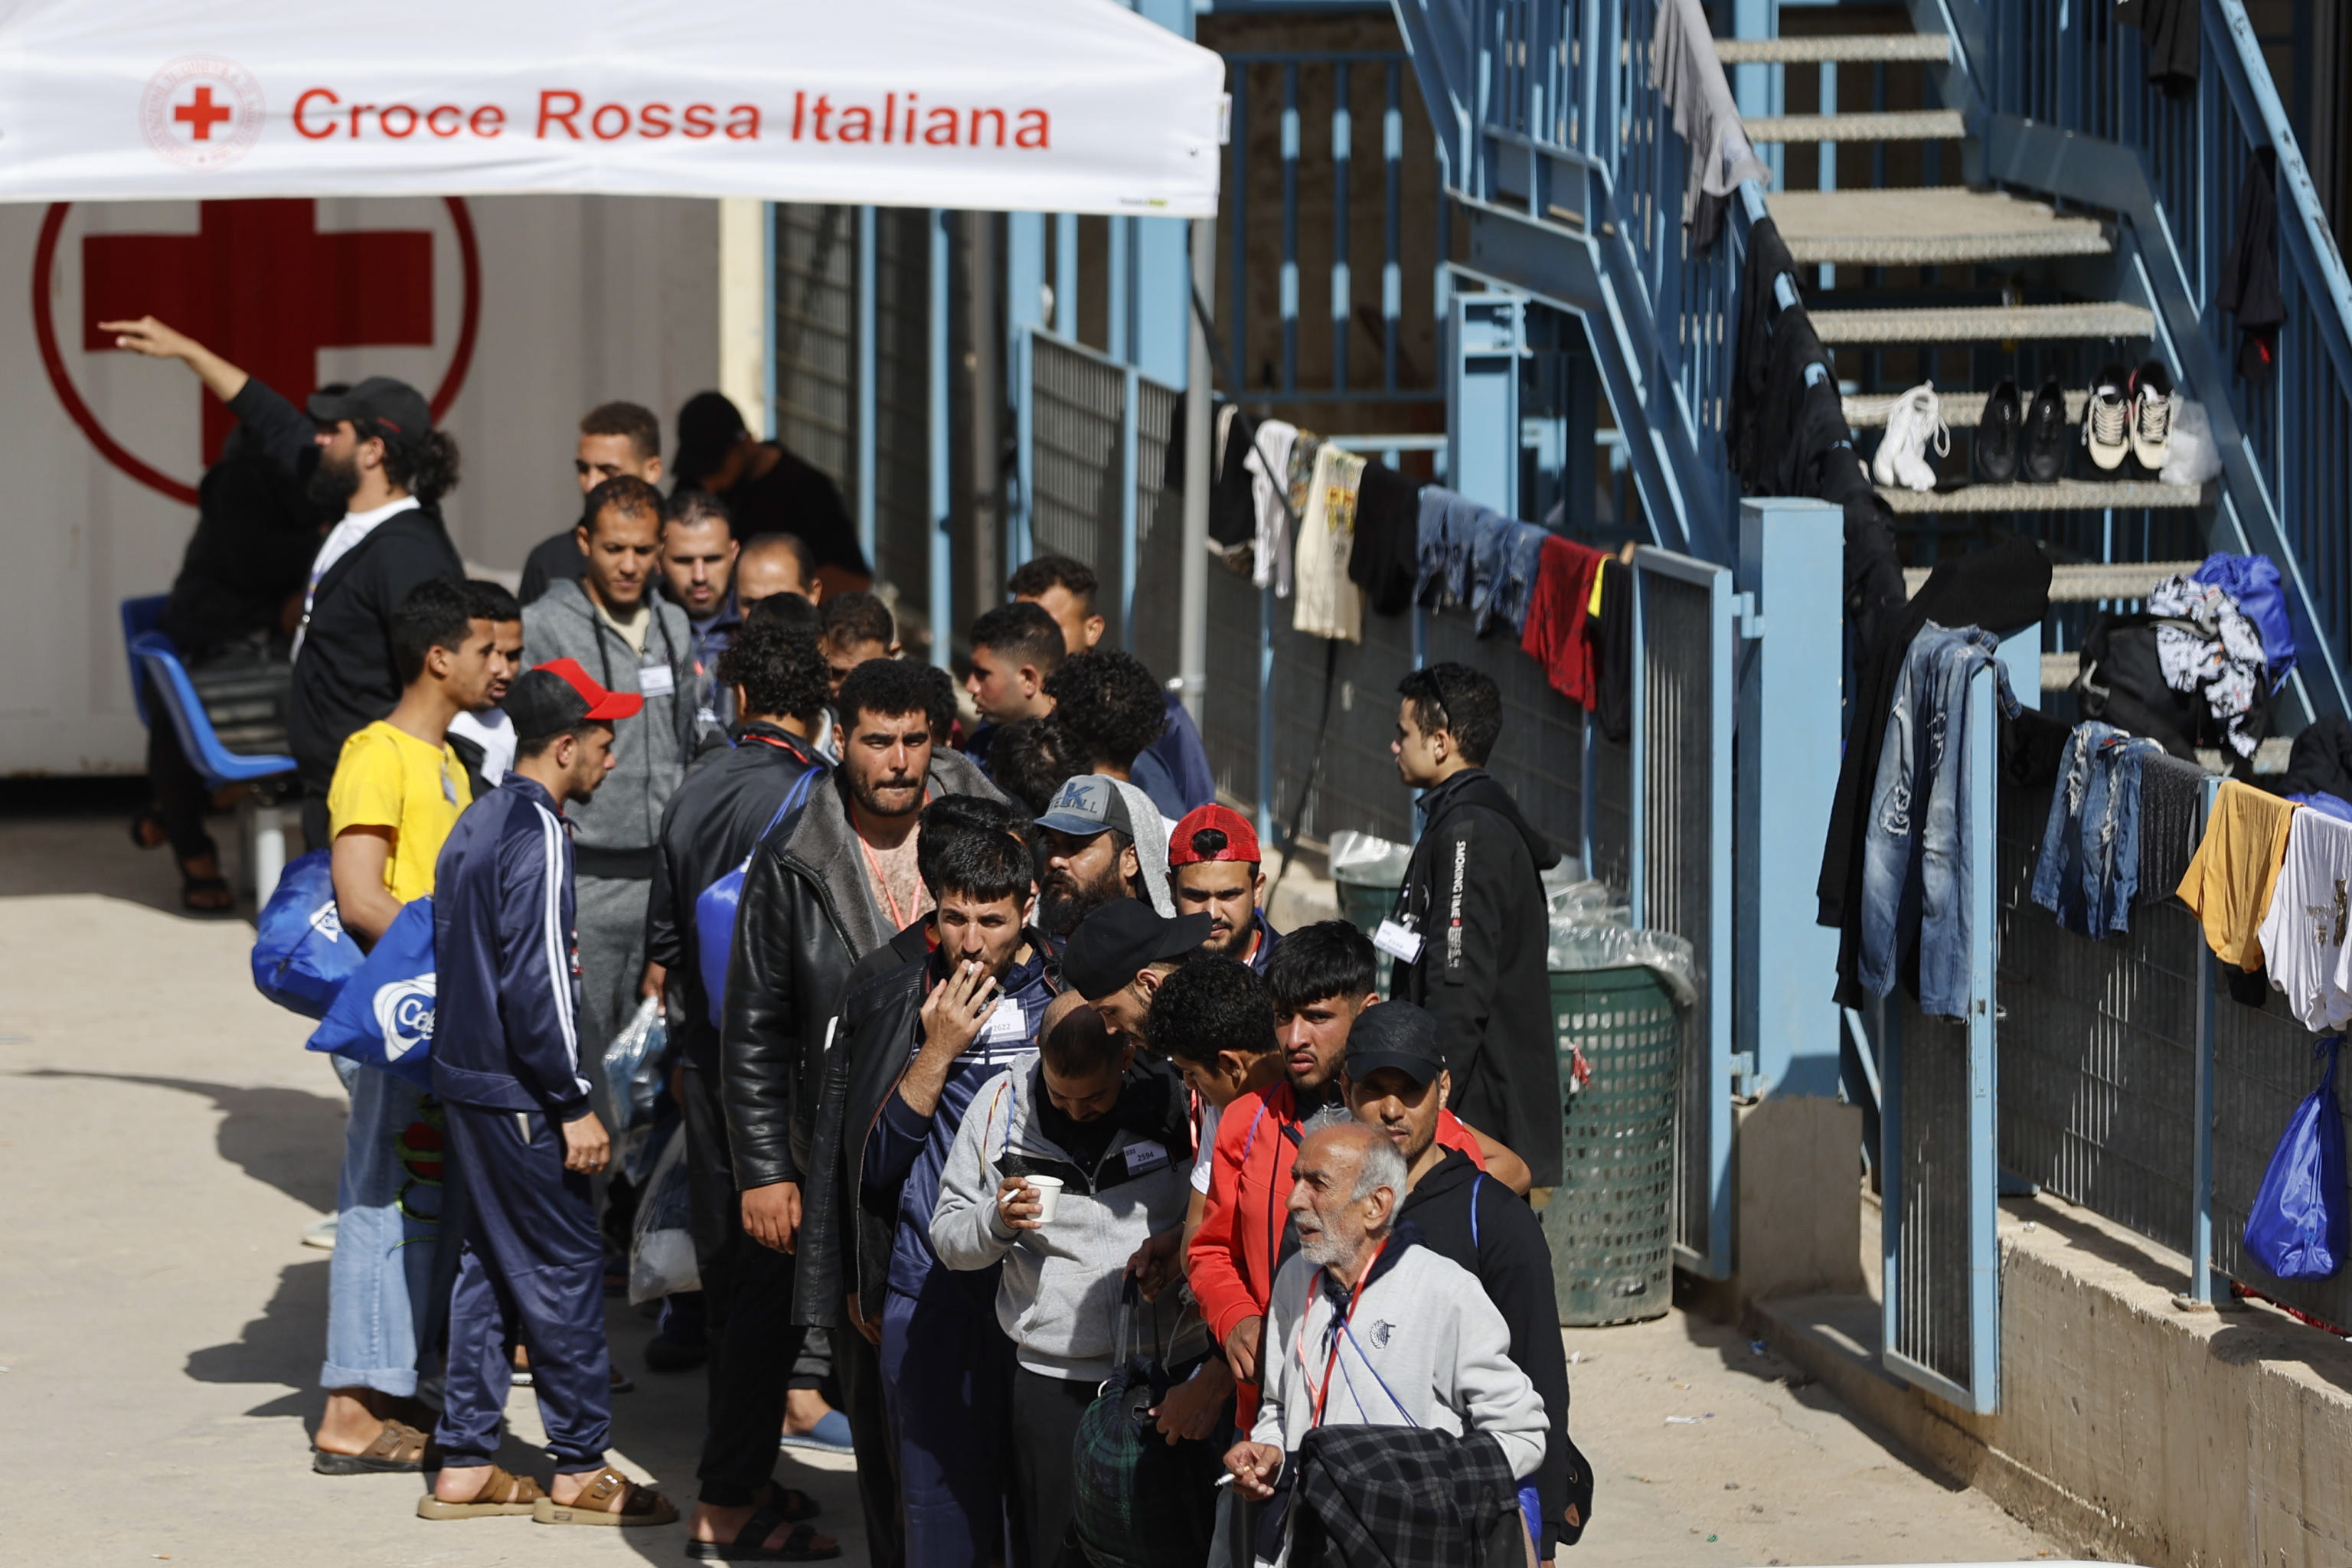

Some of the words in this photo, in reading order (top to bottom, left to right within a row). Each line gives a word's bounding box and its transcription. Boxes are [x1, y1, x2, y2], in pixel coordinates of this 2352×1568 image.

[292, 87, 506, 141] Croce
[535, 89, 761, 142] Rossa
[791, 91, 1050, 149] Italiana
[1061, 782, 1095, 808] K
[1452, 840, 1466, 893] SMOKING
[1450, 893, 1463, 919] TIME
[993, 1023, 1011, 1032] 2622
[1137, 1151, 1155, 1161] 2594
